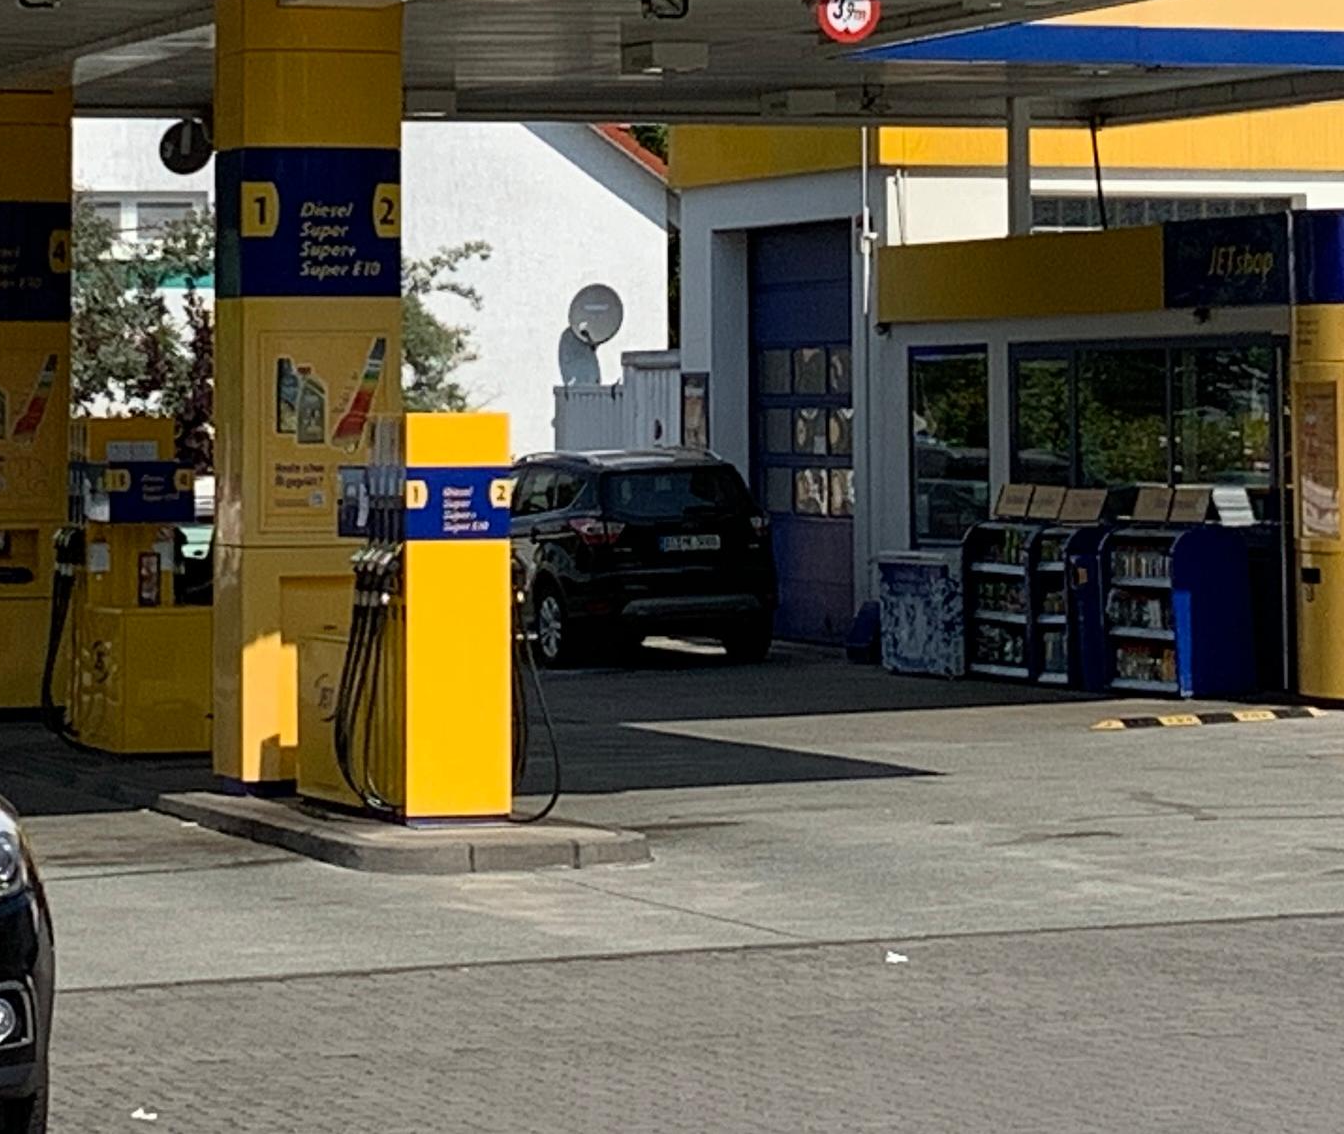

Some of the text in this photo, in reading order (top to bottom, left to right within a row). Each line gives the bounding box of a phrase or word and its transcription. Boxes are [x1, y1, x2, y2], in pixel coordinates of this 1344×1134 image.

[253, 195, 267, 225] 1
[300, 201, 354, 218] Diesel
[379, 196, 394, 226] 2
[299, 222, 349, 242] Super
[299, 259, 381, 281] Super E10
[496, 485, 506, 502] 2
